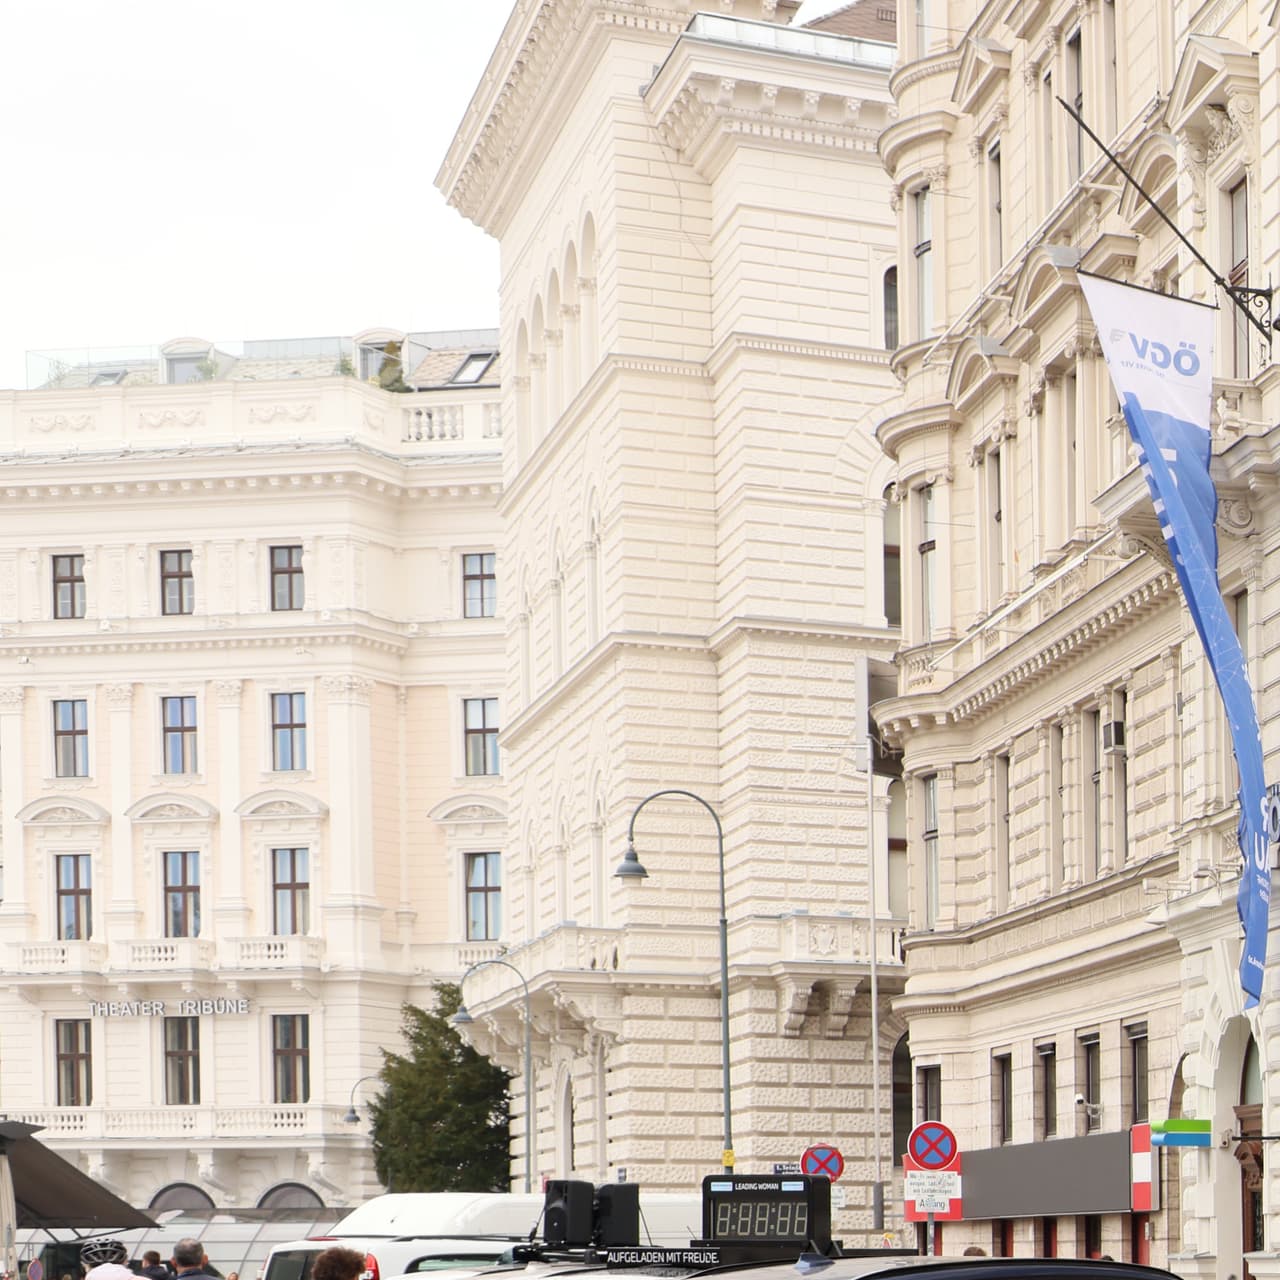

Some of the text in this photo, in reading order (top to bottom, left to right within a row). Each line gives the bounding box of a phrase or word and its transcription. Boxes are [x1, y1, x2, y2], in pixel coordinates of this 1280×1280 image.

[88, 997, 250, 1017] THEATER TRIBÜNE
[606, 1251, 665, 1263] AUFGELADEN
[665, 1251, 682, 1263] MIT
